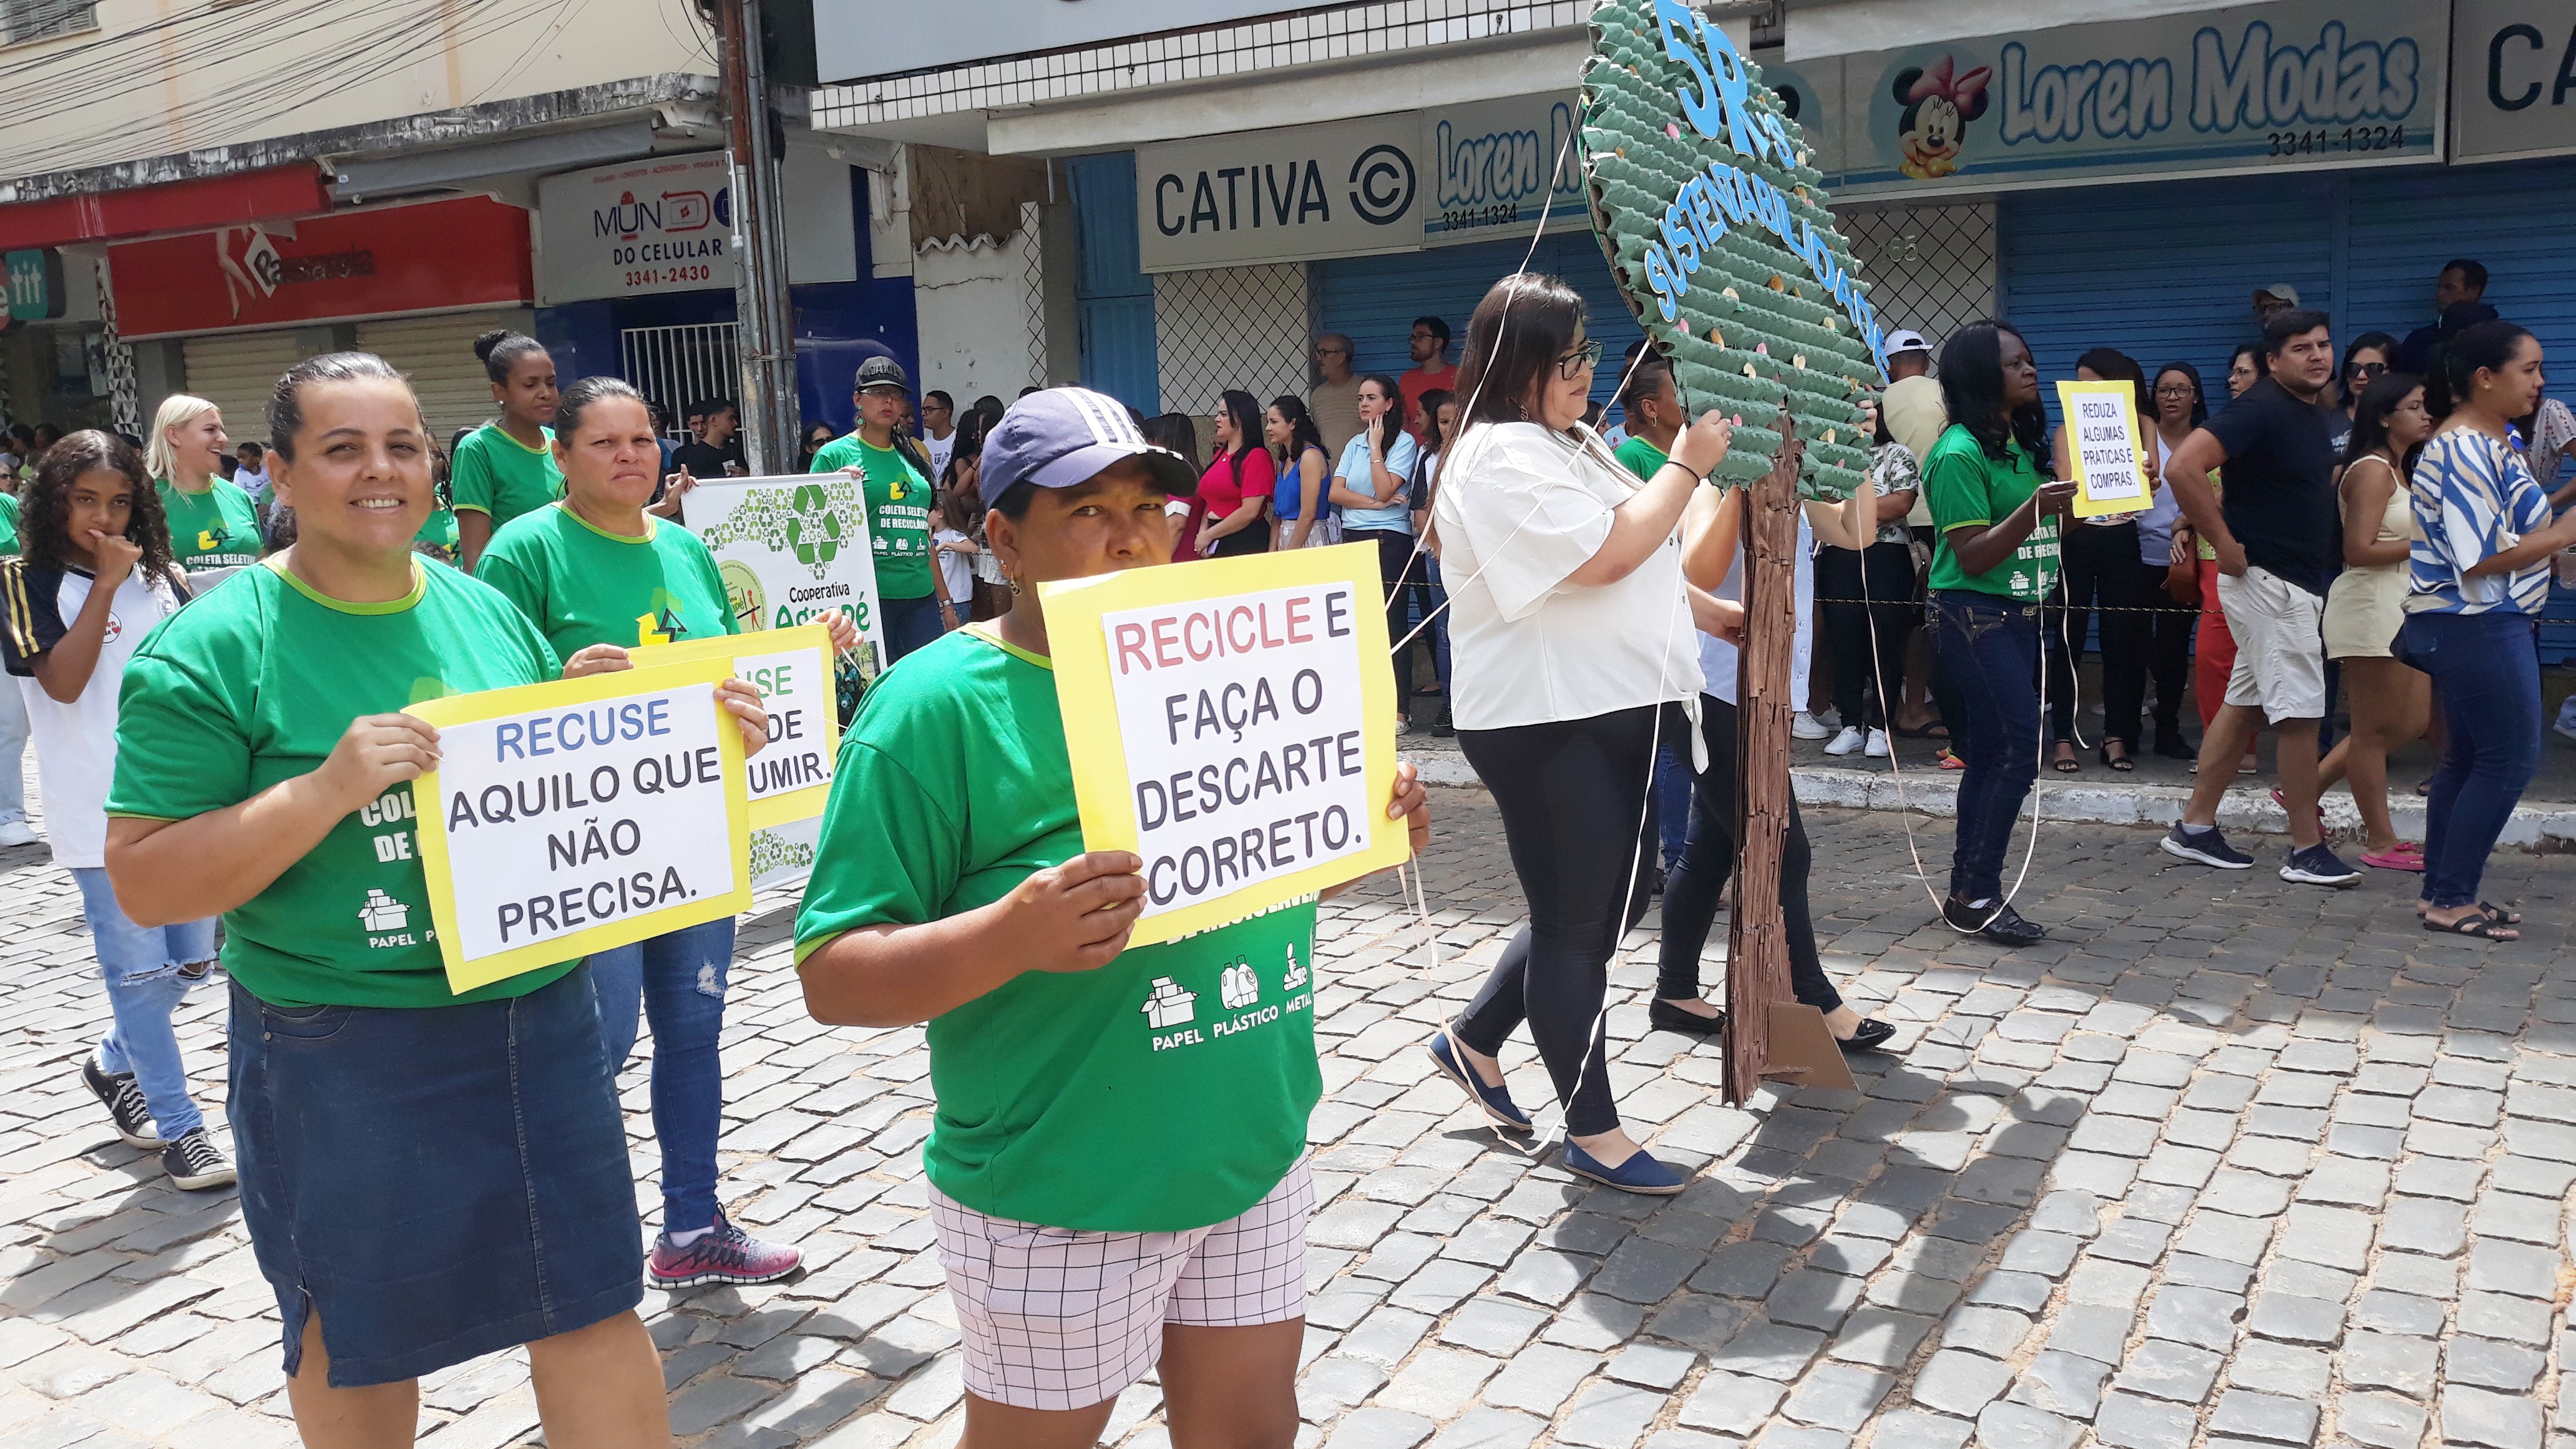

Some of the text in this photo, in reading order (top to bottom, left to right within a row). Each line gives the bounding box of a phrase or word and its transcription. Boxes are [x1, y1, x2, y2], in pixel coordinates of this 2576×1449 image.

[1999, 20, 2420, 146] Loren Modas
[2267, 125, 2404, 157] 3341-1324
[1437, 119, 1539, 209] Loren
[1155, 159, 1330, 237] CATIVA
[1443, 203, 1517, 230] 3341-1324
[614, 238, 723, 265] DO CELULAR
[627, 265, 710, 286] 3341-2430
[1644, 161, 1891, 386] SUSTENTABILIDADE
[2082, 402, 2117, 418] REDUZA
[2084, 426, 2125, 442] ALGUMAS
[2083, 446, 2134, 466] PRÁTICAS E
[2091, 471, 2135, 489] COMPRAS.
[879, 504, 929, 519] COLETA SELET
[880, 518, 891, 528] DE
[186, 554, 222, 565] COLETA
[2017, 542, 2059, 560] DE RECI
[789, 581, 850, 603] Cooperativa
[776, 591, 871, 632] Agpé
[1115, 591, 1350, 675] RECICLE E
[1166, 669, 1322, 744] FAÇA O
[497, 699, 670, 763] RECUSE
[449, 747, 721, 832] AQUILO QUE
[1136, 730, 1362, 832] DESCARTE
[360, 791, 416, 827] COL
[374, 832, 412, 862] DE
[548, 816, 640, 871] NÃO
[1148, 805, 1362, 906] CORRETO.
[499, 866, 697, 943] PRECISA.
[369, 930, 439, 949] PAPEL P
[1153, 991, 1312, 1051] PAPEL PLÁSTICO METAL
